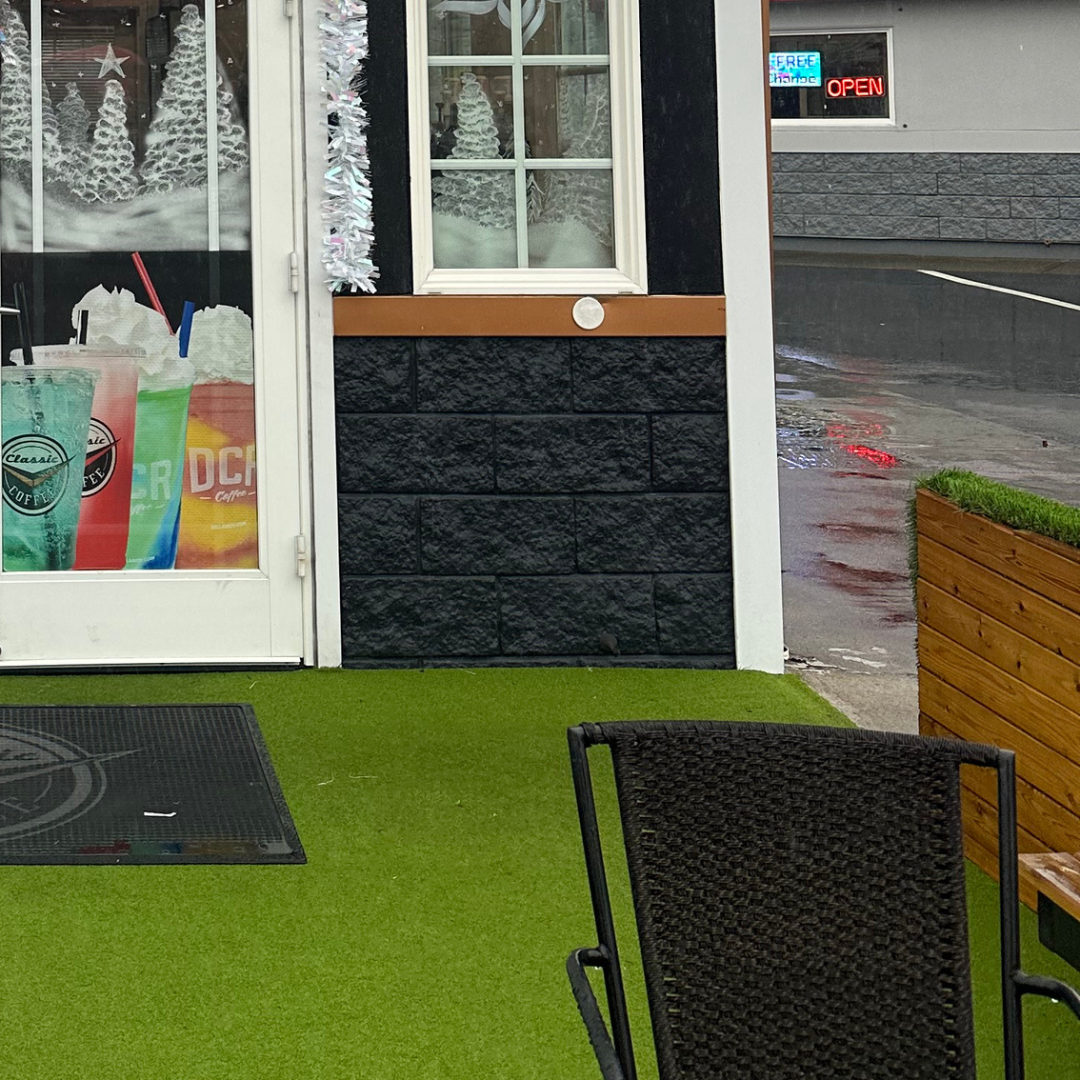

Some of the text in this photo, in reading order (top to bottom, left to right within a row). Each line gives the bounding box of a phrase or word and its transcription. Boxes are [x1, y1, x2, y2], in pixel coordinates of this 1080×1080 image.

[776, 54, 816, 68] FREE
[827, 77, 883, 97] OPEN
[5, 453, 60, 465] Classic
[131, 459, 172, 500] CR
[8, 484, 56, 505] COFFEE
[215, 491, 246, 503] Coffee
